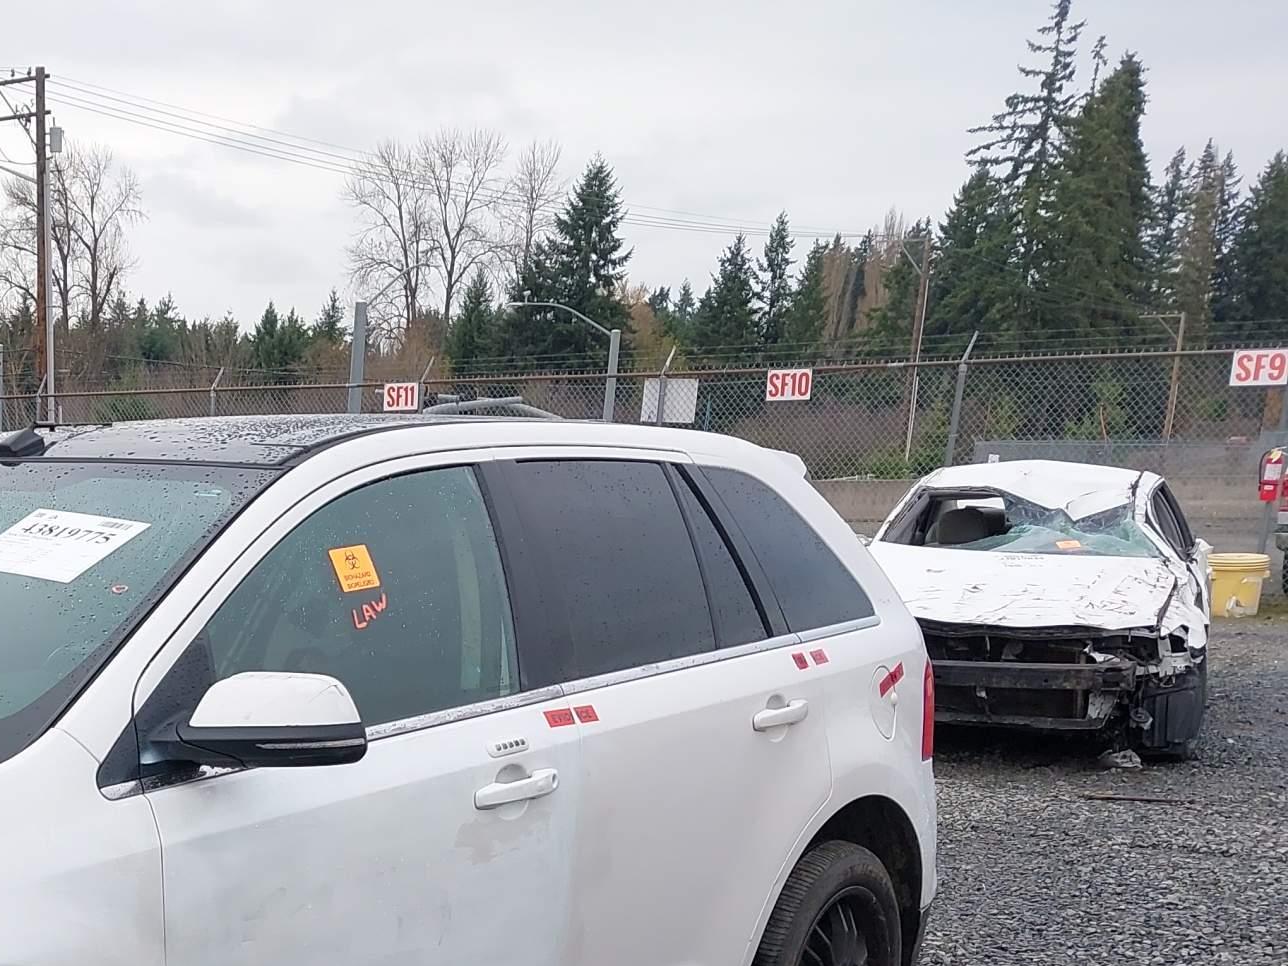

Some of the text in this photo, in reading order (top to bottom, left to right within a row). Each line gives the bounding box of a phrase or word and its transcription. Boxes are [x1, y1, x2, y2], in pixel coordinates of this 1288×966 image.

[1235, 352, 1287, 382] SF9
[386, 385, 416, 408] SF11
[768, 372, 810, 398] SF10
[21, 522, 117, 544] 43819775
[352, 593, 388, 630] LAW
